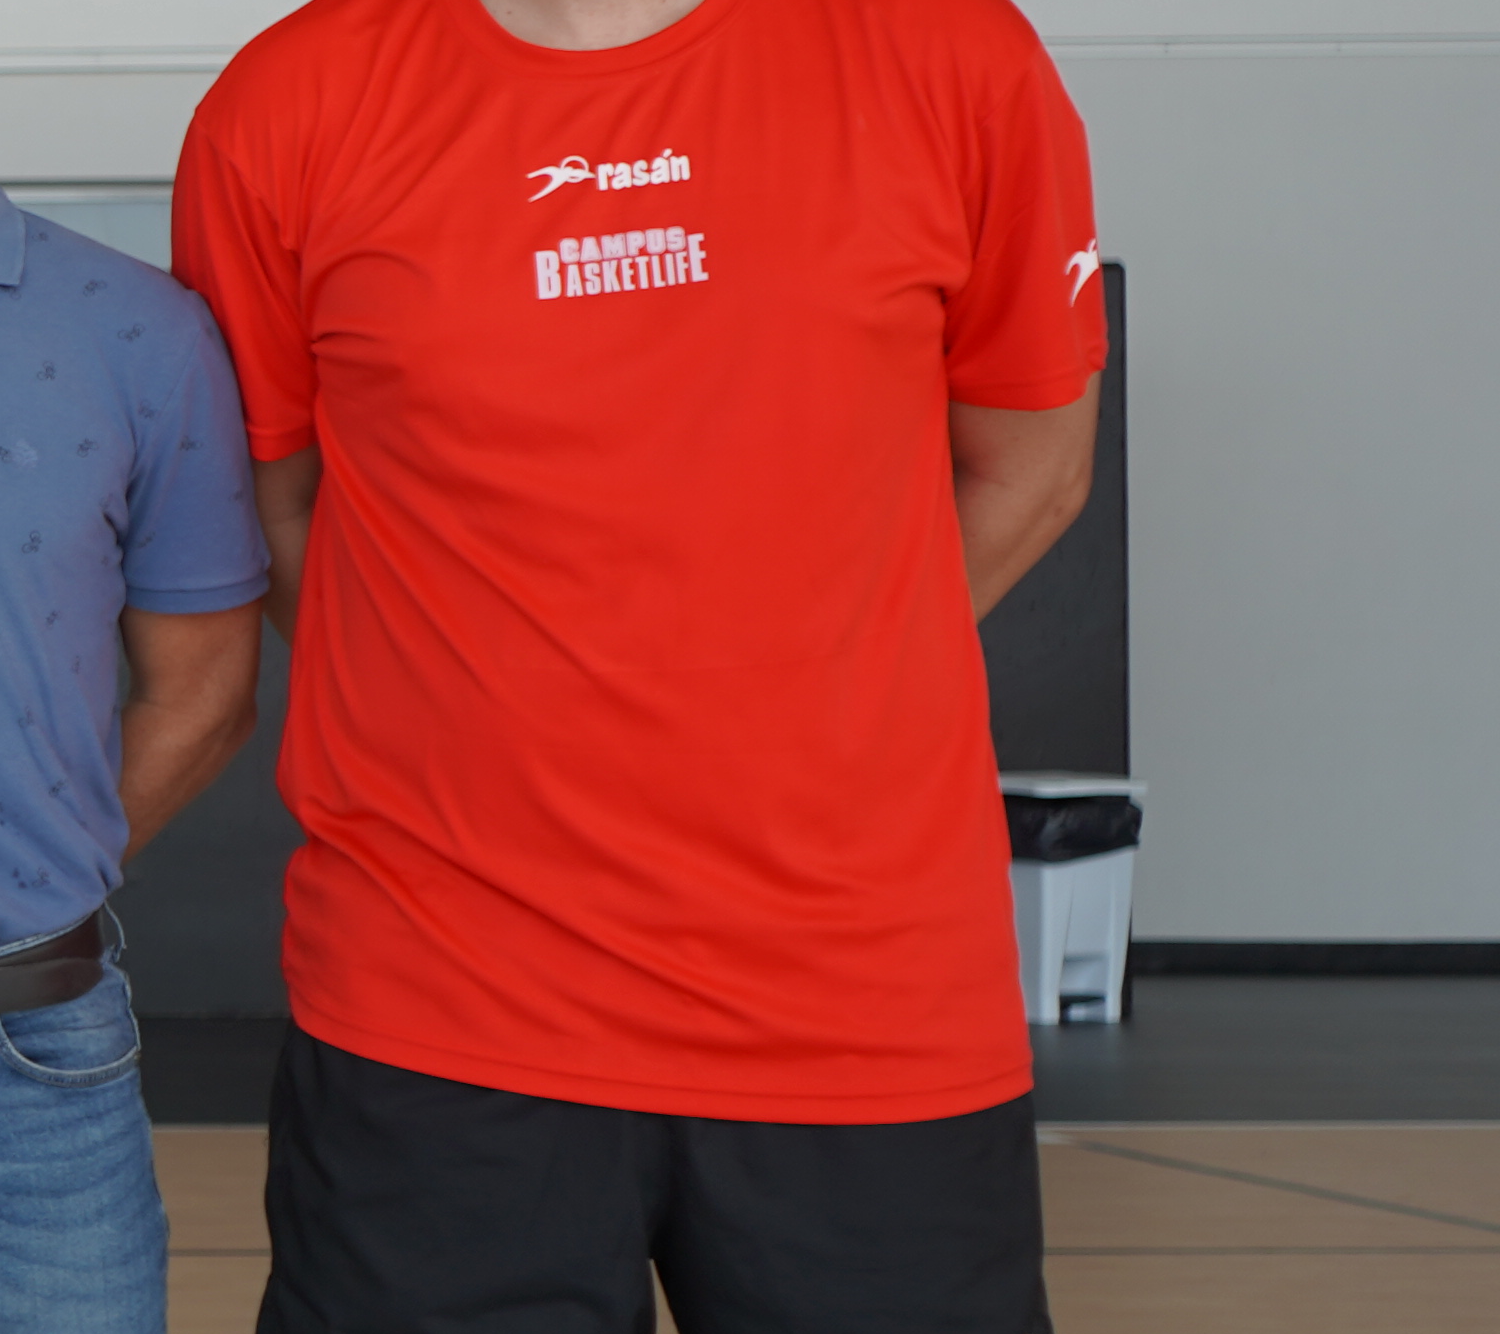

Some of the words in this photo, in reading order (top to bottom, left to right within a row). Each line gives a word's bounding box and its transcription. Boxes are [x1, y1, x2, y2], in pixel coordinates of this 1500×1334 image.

[596, 148, 691, 191] rasán
[559, 225, 686, 263] CAMPUS
[534, 232, 709, 300] BASKETLIFE
